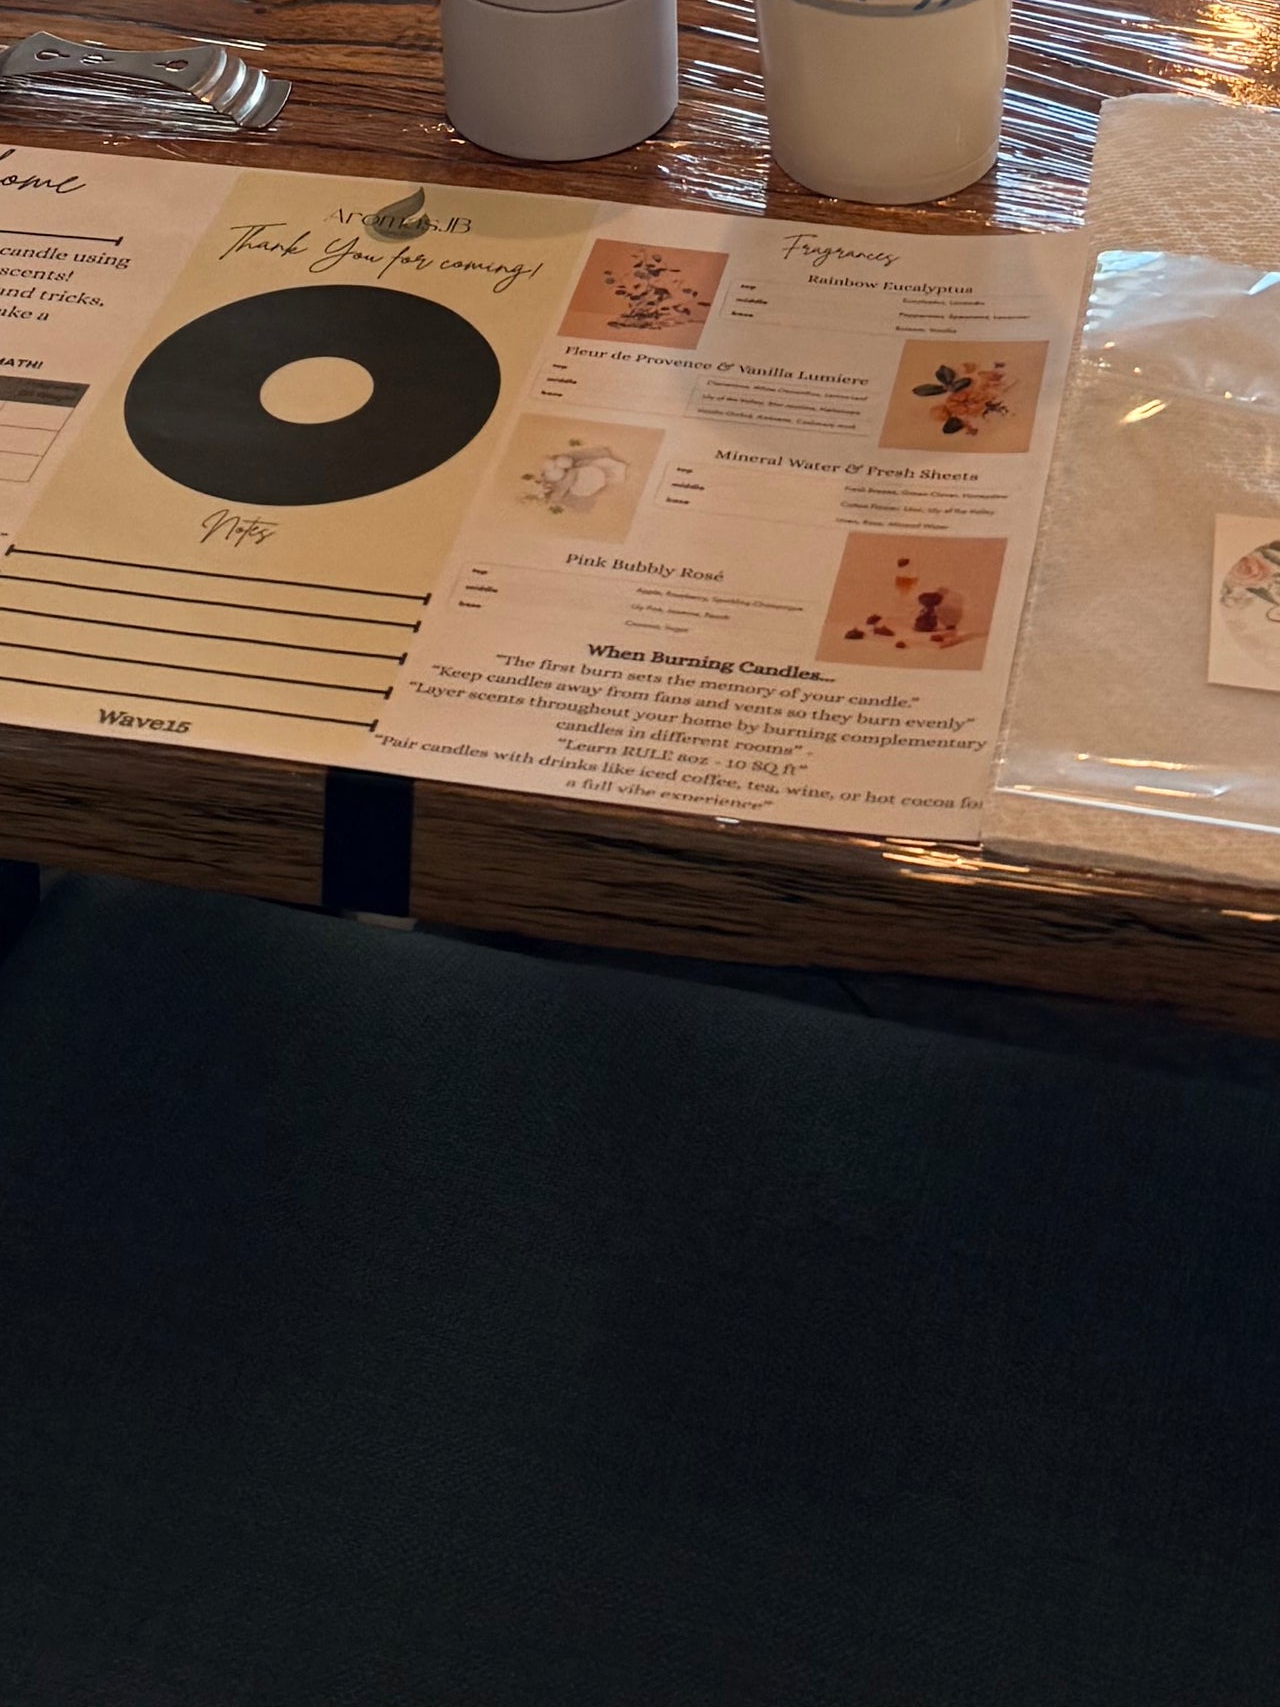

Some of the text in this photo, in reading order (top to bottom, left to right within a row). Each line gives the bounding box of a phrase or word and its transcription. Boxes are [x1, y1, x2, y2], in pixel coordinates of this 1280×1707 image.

[72, 251, 131, 270] using
[218, 222, 545, 294] Thank You for coming!
[782, 233, 904, 268] Fragrances
[806, 273, 879, 289] Rainbow
[38, 289, 104, 307] tricks.
[35, 311, 50, 321] a
[564, 344, 609, 359] Fleur
[609, 349, 632, 361] de
[634, 353, 712, 370] Provence
[738, 363, 793, 379] Vanilla
[713, 448, 783, 467] Mineral
[788, 457, 841, 473] Water
[865, 465, 915, 479] Fresh
[918, 468, 979, 481] Sheets
[200, 508, 279, 548] Notes
[564, 552, 724, 582] Pink Bubbly Rosé
[587, 642, 646, 662] When
[648, 649, 735, 675] Burning
[537, 657, 576, 674] first
[579, 662, 623, 680] burn
[625, 672, 663, 684] sets
[666, 673, 696, 688] the
[697, 679, 777, 699] memory
[777, 686, 802, 700] of
[798, 691, 846, 704] your
[484, 673, 553, 690] candles
[554, 681, 603, 698] away
[605, 684, 650, 701] from
[652, 689, 692, 706] fans
[693, 697, 730, 710] and
[733, 702, 783, 716] vents
[785, 708, 808, 719] so
[810, 707, 853, 726] they
[855, 711, 901, 727] burn
[98, 707, 192, 735] Wave15
[466, 690, 526, 705] scents
[528, 694, 630, 719] throughout
[631, 710, 679, 723] your
[680, 711, 733, 730] home
[735, 717, 760, 735] by
[762, 721, 838, 744] burning
[839, 732, 987, 752] complementary
